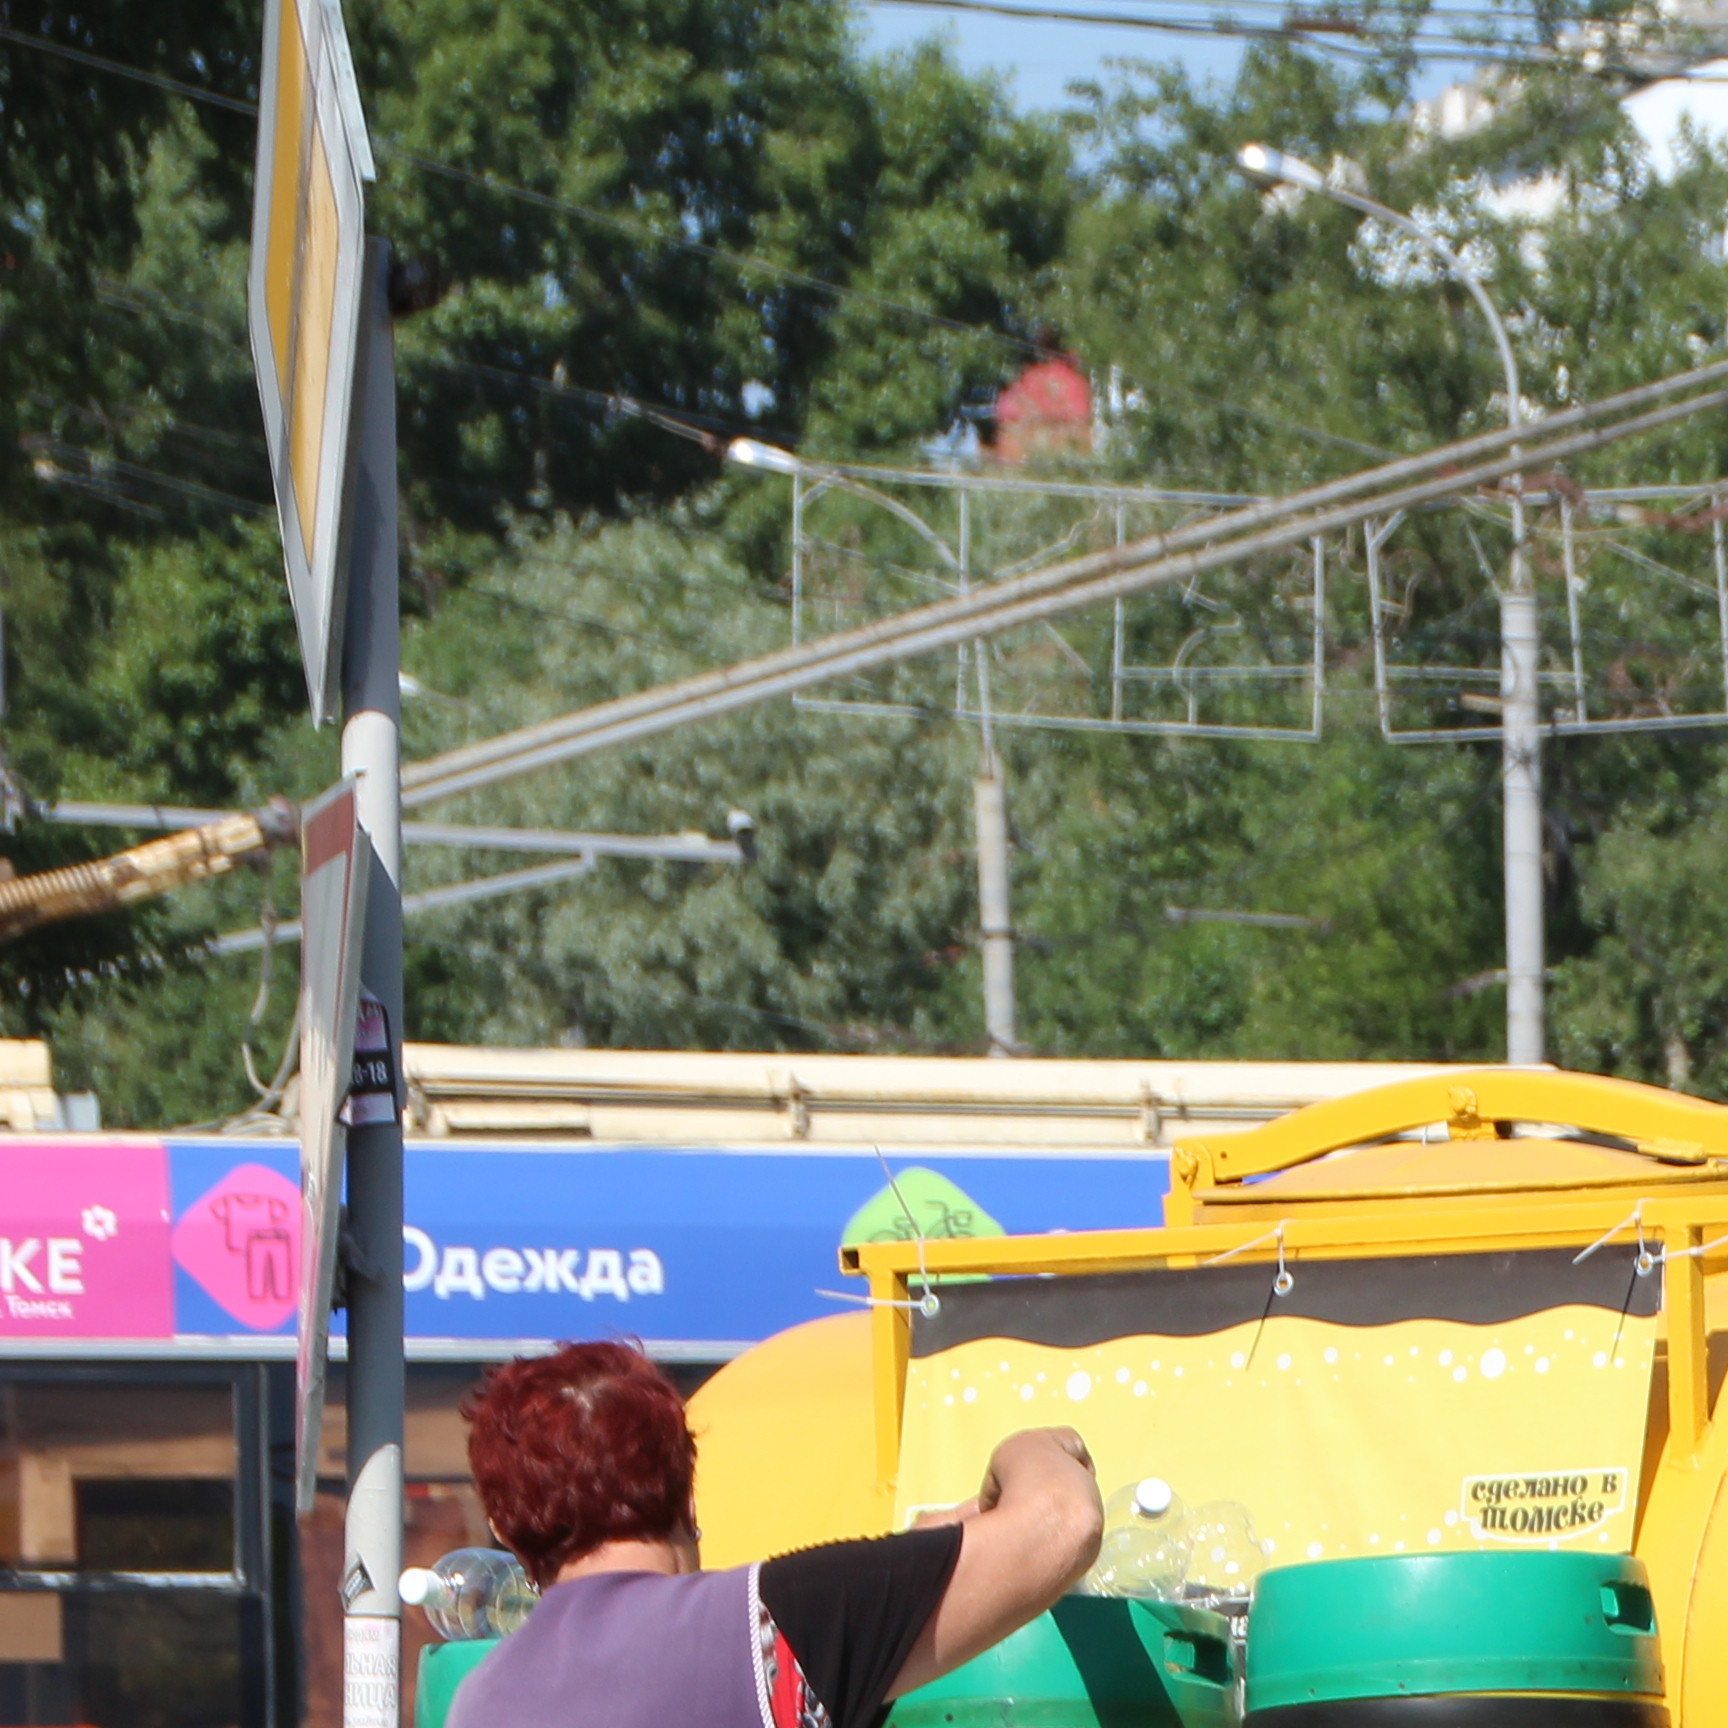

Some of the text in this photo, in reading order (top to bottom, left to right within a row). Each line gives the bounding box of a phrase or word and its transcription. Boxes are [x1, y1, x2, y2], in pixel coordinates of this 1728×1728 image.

[351, 1060, 387, 1085] 8-18
[402, 1224, 666, 1302] Одежда
[1470, 1474, 1589, 1504] сделано
